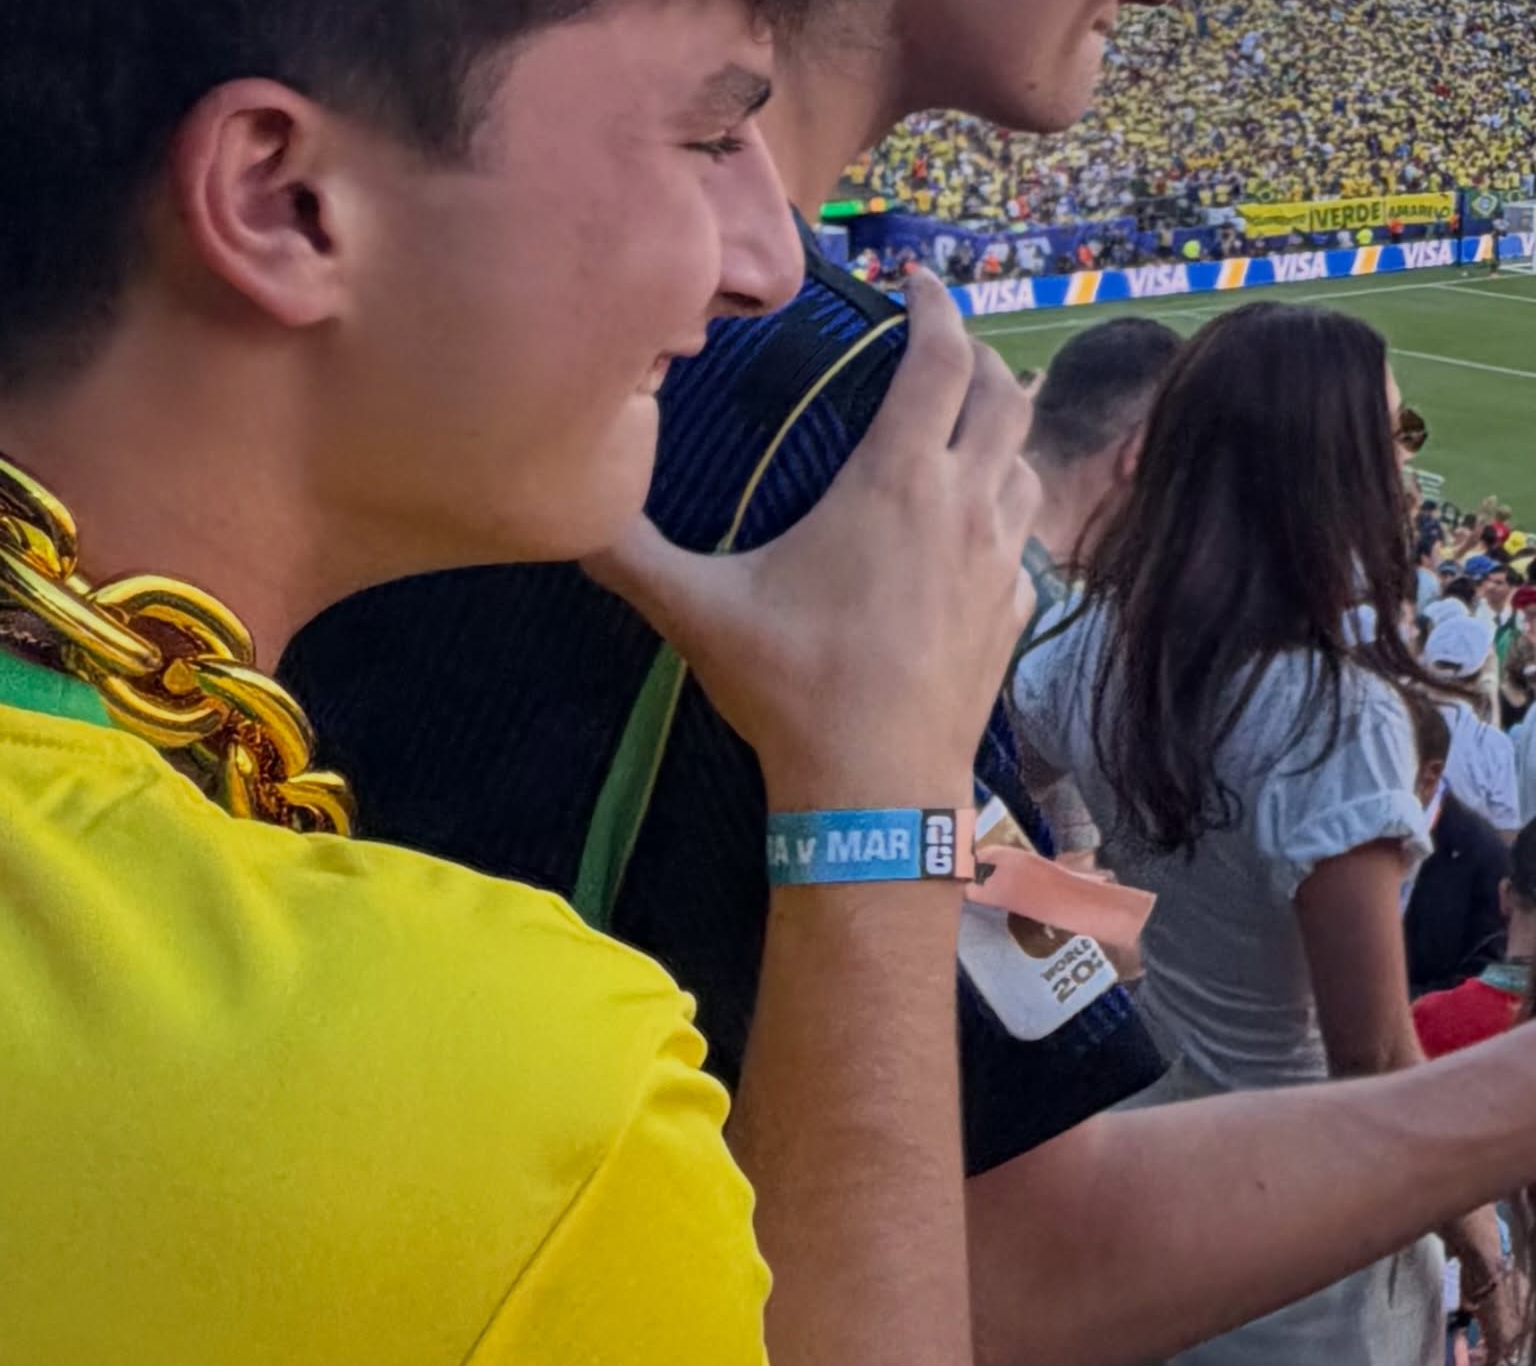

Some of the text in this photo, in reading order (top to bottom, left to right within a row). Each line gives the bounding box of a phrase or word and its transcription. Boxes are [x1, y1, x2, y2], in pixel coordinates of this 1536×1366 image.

[1315, 201, 1381, 228] VERDE
[1271, 251, 1329, 282] VISA
[1401, 240, 1455, 269] VISA
[969, 277, 1036, 316] VISA
[1125, 262, 1189, 298] VISA
[826, 828, 911, 864] MAR
